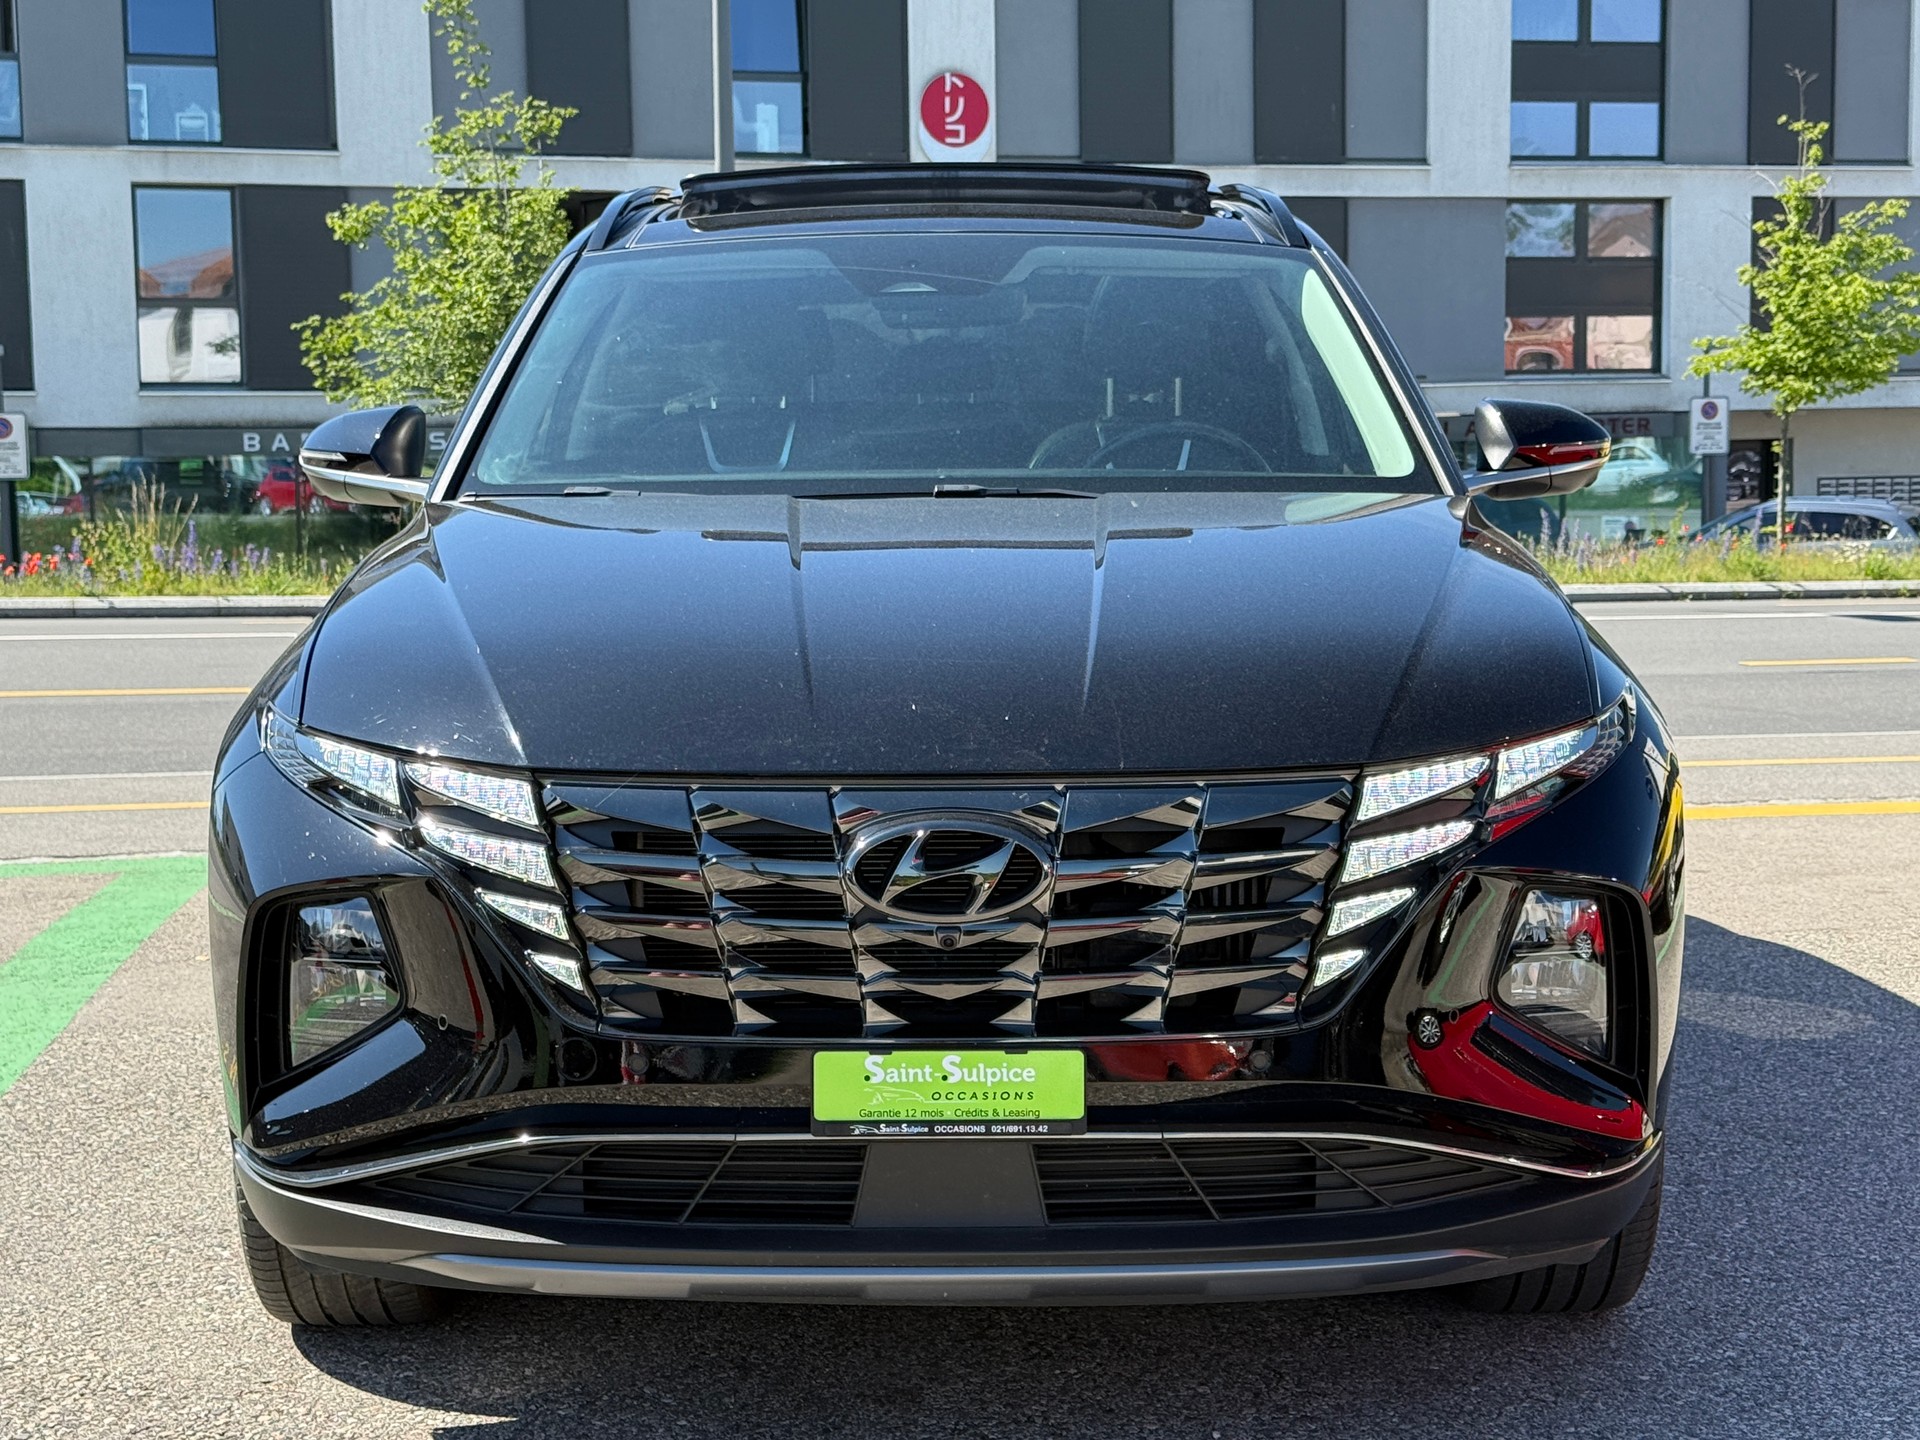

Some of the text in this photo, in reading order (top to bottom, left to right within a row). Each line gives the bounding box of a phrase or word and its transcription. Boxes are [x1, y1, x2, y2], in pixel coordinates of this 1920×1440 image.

[944, 72, 965, 144] トリコ
[864, 1054, 1036, 1087] Saint-Sulpice
[931, 1091, 1035, 1101] OCCASIONS
[859, 1107, 1041, 1119] Garantie 12 mois Crédits & Leasing
[934, 1125, 986, 1134] OCCASIONS
[991, 1125, 1049, 1134] 021/691.13.42
